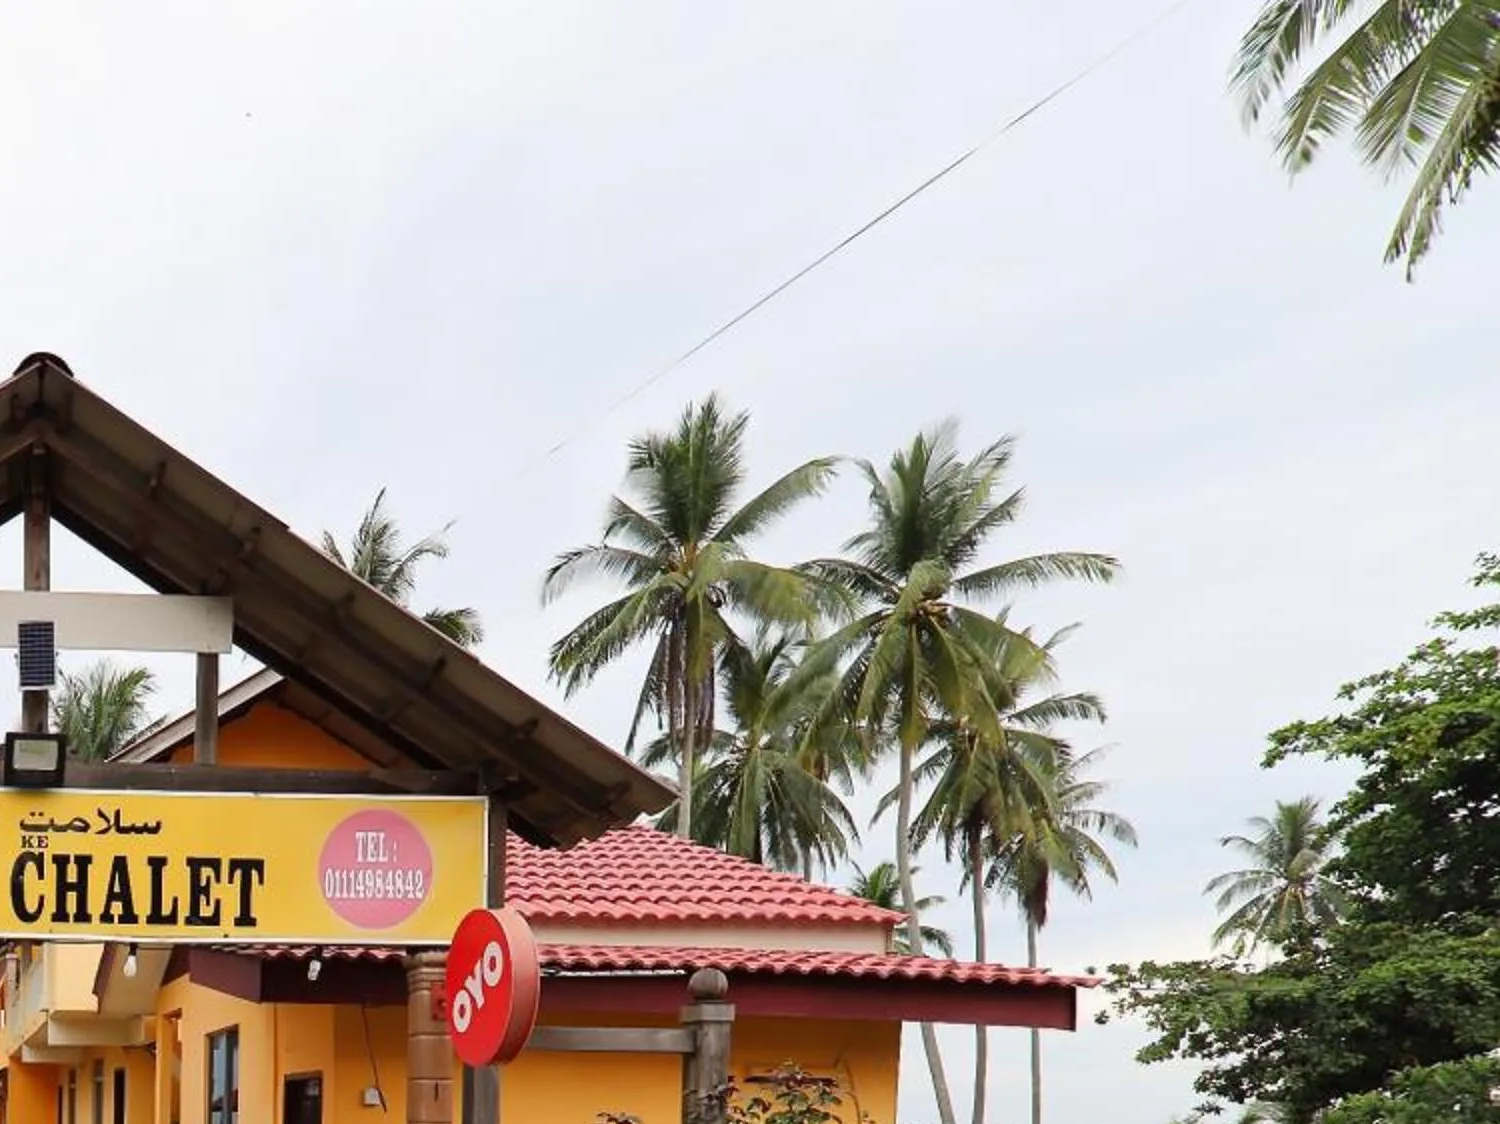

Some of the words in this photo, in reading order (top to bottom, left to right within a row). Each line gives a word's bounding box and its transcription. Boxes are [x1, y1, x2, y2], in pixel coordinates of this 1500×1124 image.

[19, 807, 163, 835] سلامت
[20, 835, 49, 849] KE
[9, 850, 265, 928] CHALET
[452, 940, 504, 1034] OYO
